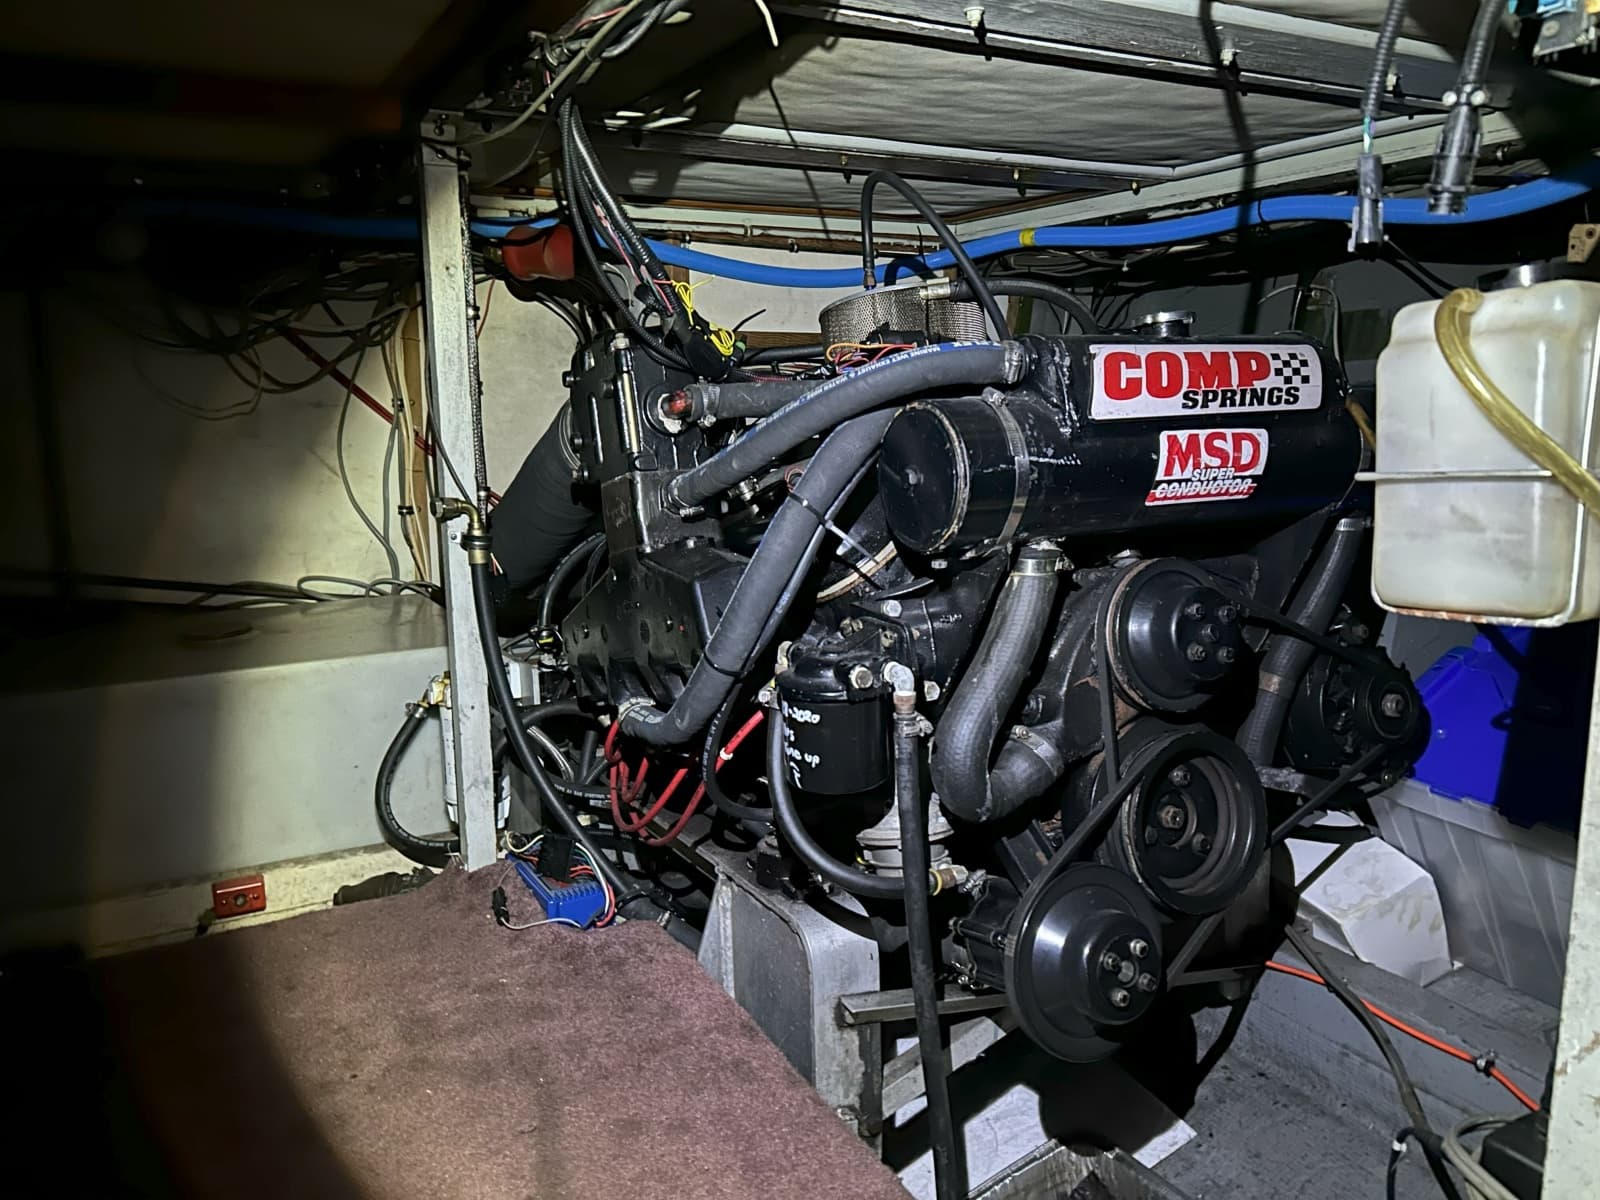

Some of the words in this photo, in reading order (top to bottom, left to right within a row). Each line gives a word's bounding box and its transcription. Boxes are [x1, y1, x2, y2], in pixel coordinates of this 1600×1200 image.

[857, 359, 891, 376] EXHAUST
[892, 353, 910, 362] WET
[1104, 351, 1271, 401] COMP
[1181, 386, 1300, 410] SPRINGS
[1163, 431, 1262, 477] MSD
[1191, 467, 1235, 482] SUPER
[1155, 478, 1254, 499] CONDUCTOR
